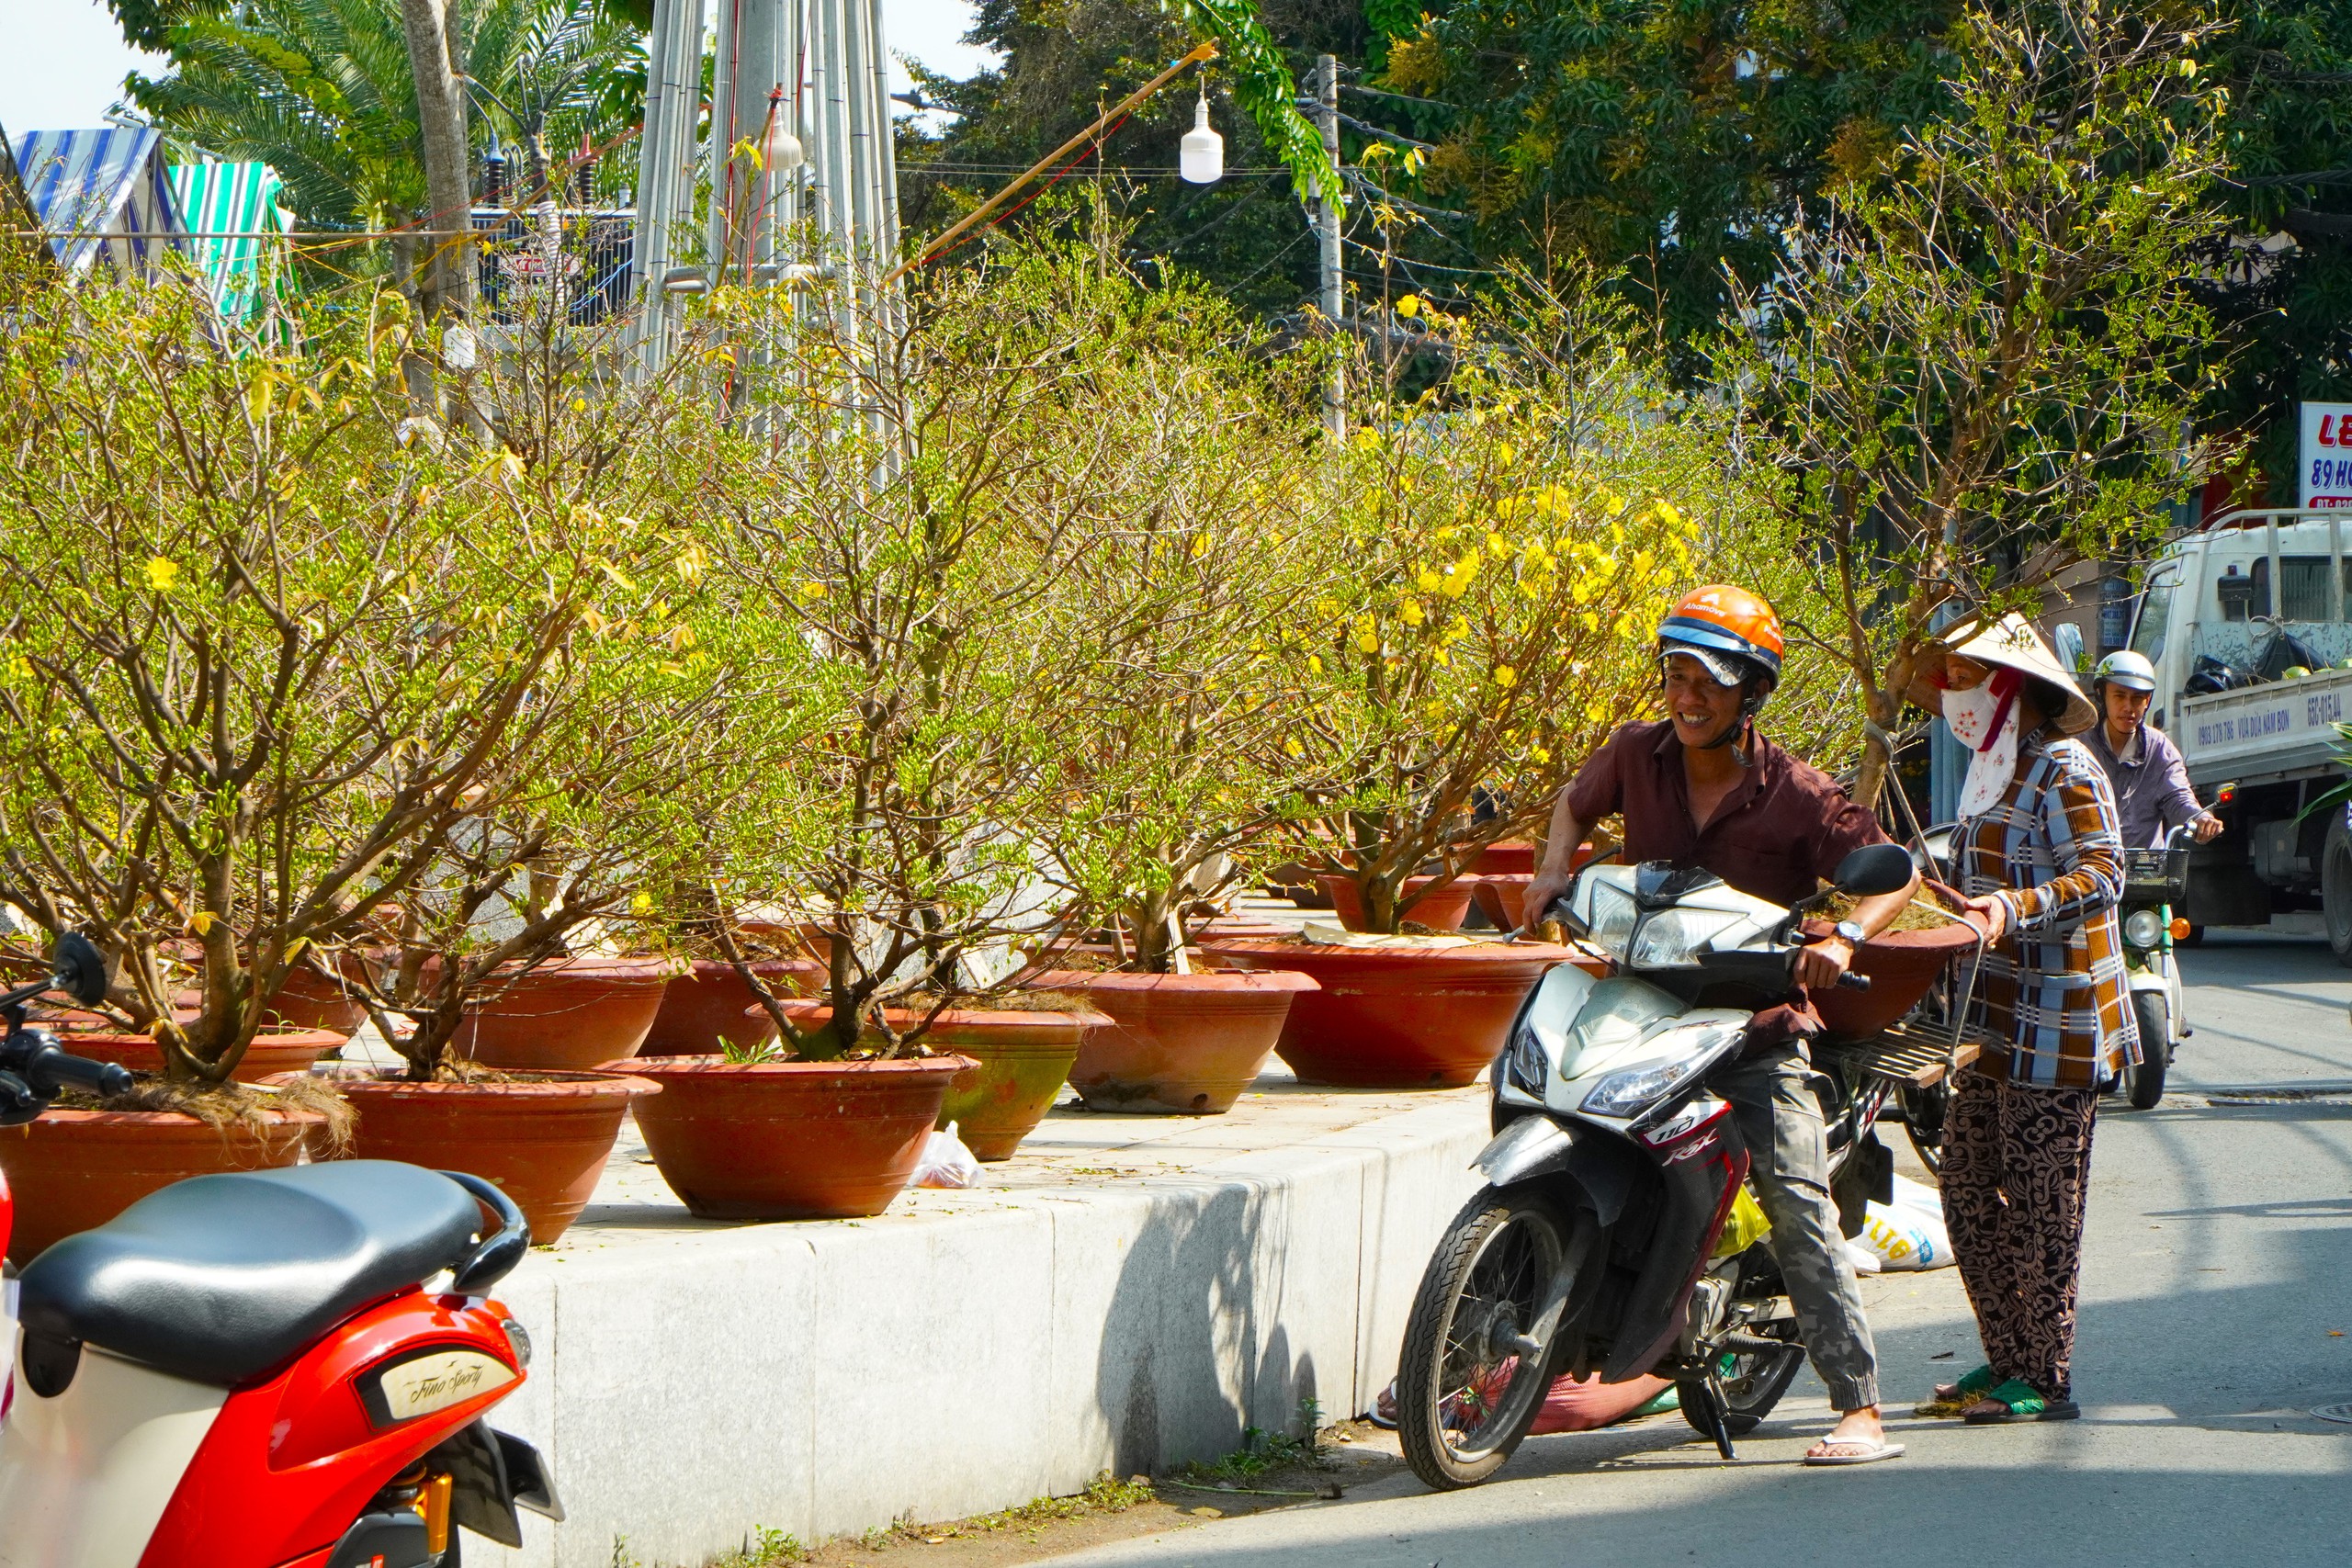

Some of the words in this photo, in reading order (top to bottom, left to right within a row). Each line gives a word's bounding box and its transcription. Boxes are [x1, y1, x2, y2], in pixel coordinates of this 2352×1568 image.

[2312, 458, 2334, 489] 89
[1683, 602, 1727, 618] Ahamove
[1656, 1116, 1695, 1143] 110
[411, 1375, 446, 1404] Fino
[448, 1364, 485, 1394] Sporty
